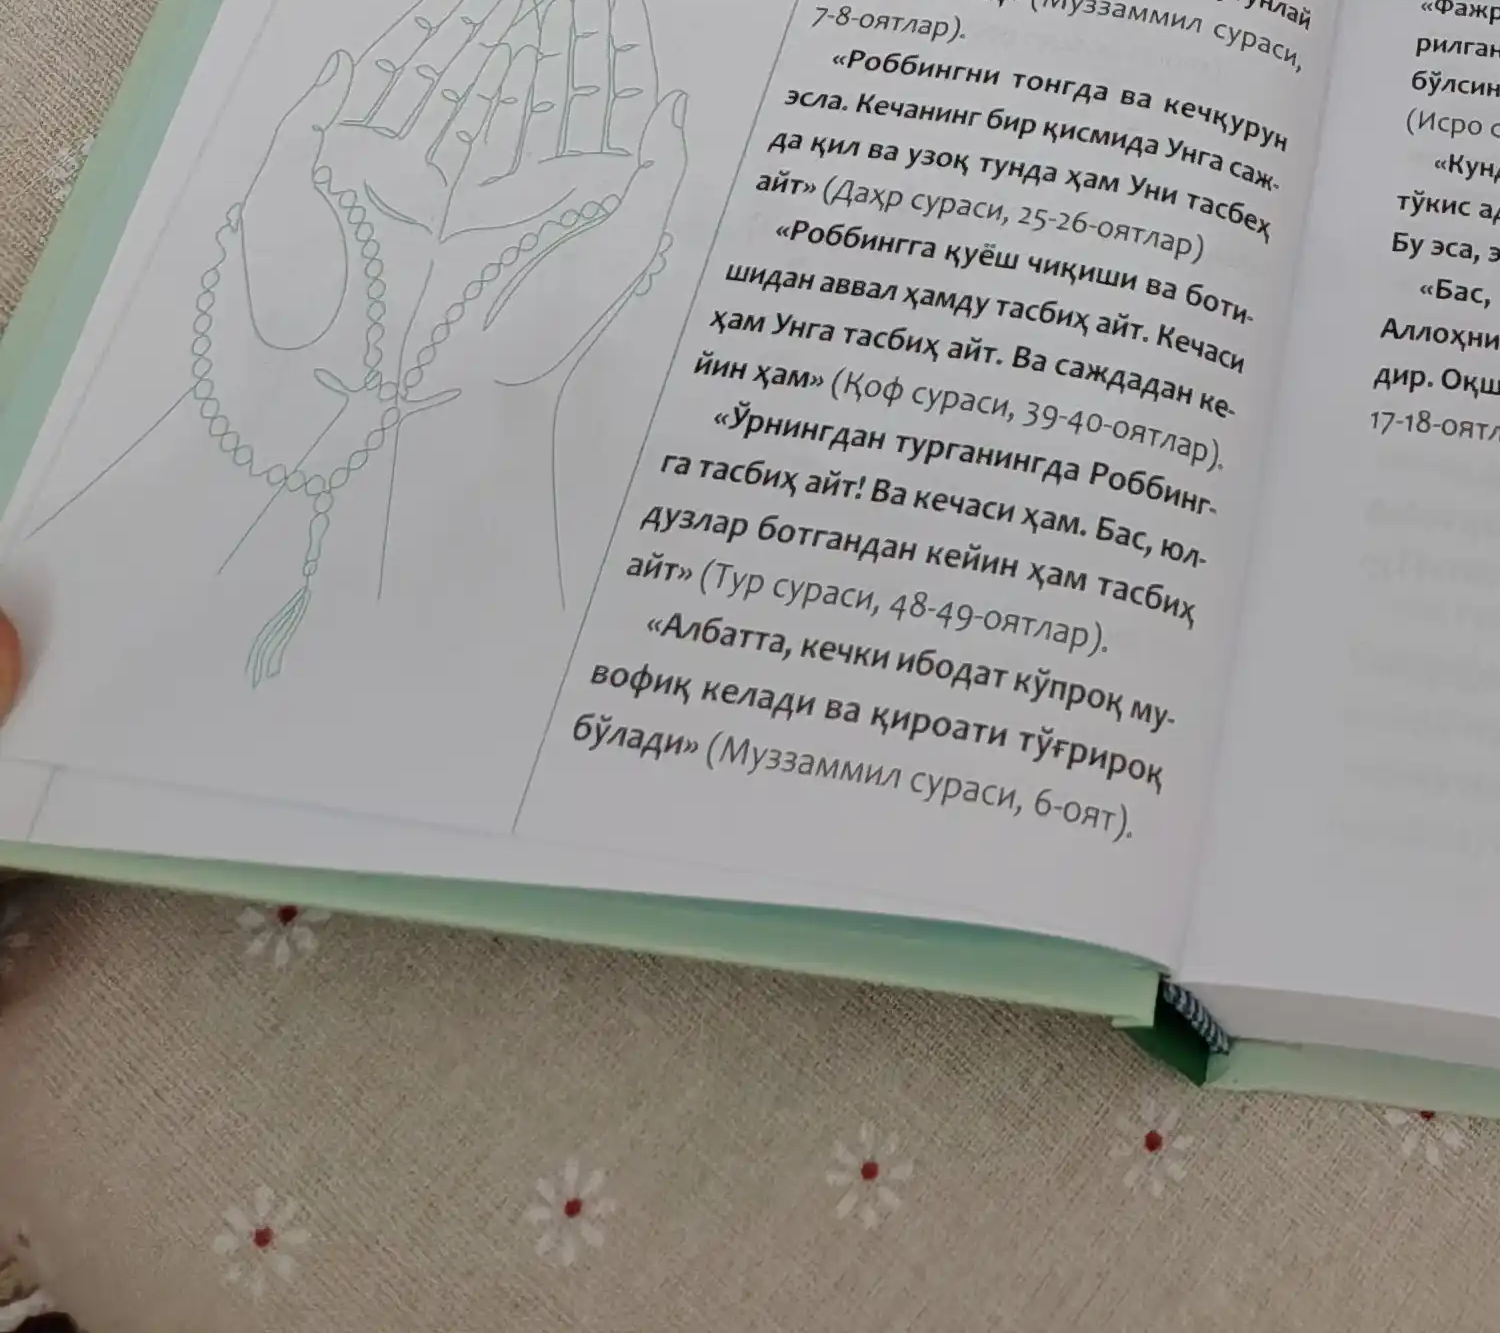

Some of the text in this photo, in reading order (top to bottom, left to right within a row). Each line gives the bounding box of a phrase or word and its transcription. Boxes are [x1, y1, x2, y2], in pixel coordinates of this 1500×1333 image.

[1013, 73, 1108, 104] тонгда
[1120, 90, 1152, 109] ва
[1164, 98, 1288, 152] кечқурун
[756, 175, 816, 195] айт»
[911, 193, 1008, 226] сураси,
[1392, 232, 1424, 259] Бу
[1431, 240, 1480, 265] эса,
[1420, 279, 1491, 309] «Бас,
[647, 613, 1175, 733] «Албатта, кечки ибодат кўпроқ му-
[590, 663, 1163, 795] вофиқ келади ва қироати тўғрироқ
[910, 772, 1022, 817] сураси,
[1035, 789, 1132, 843] 6-оят).
